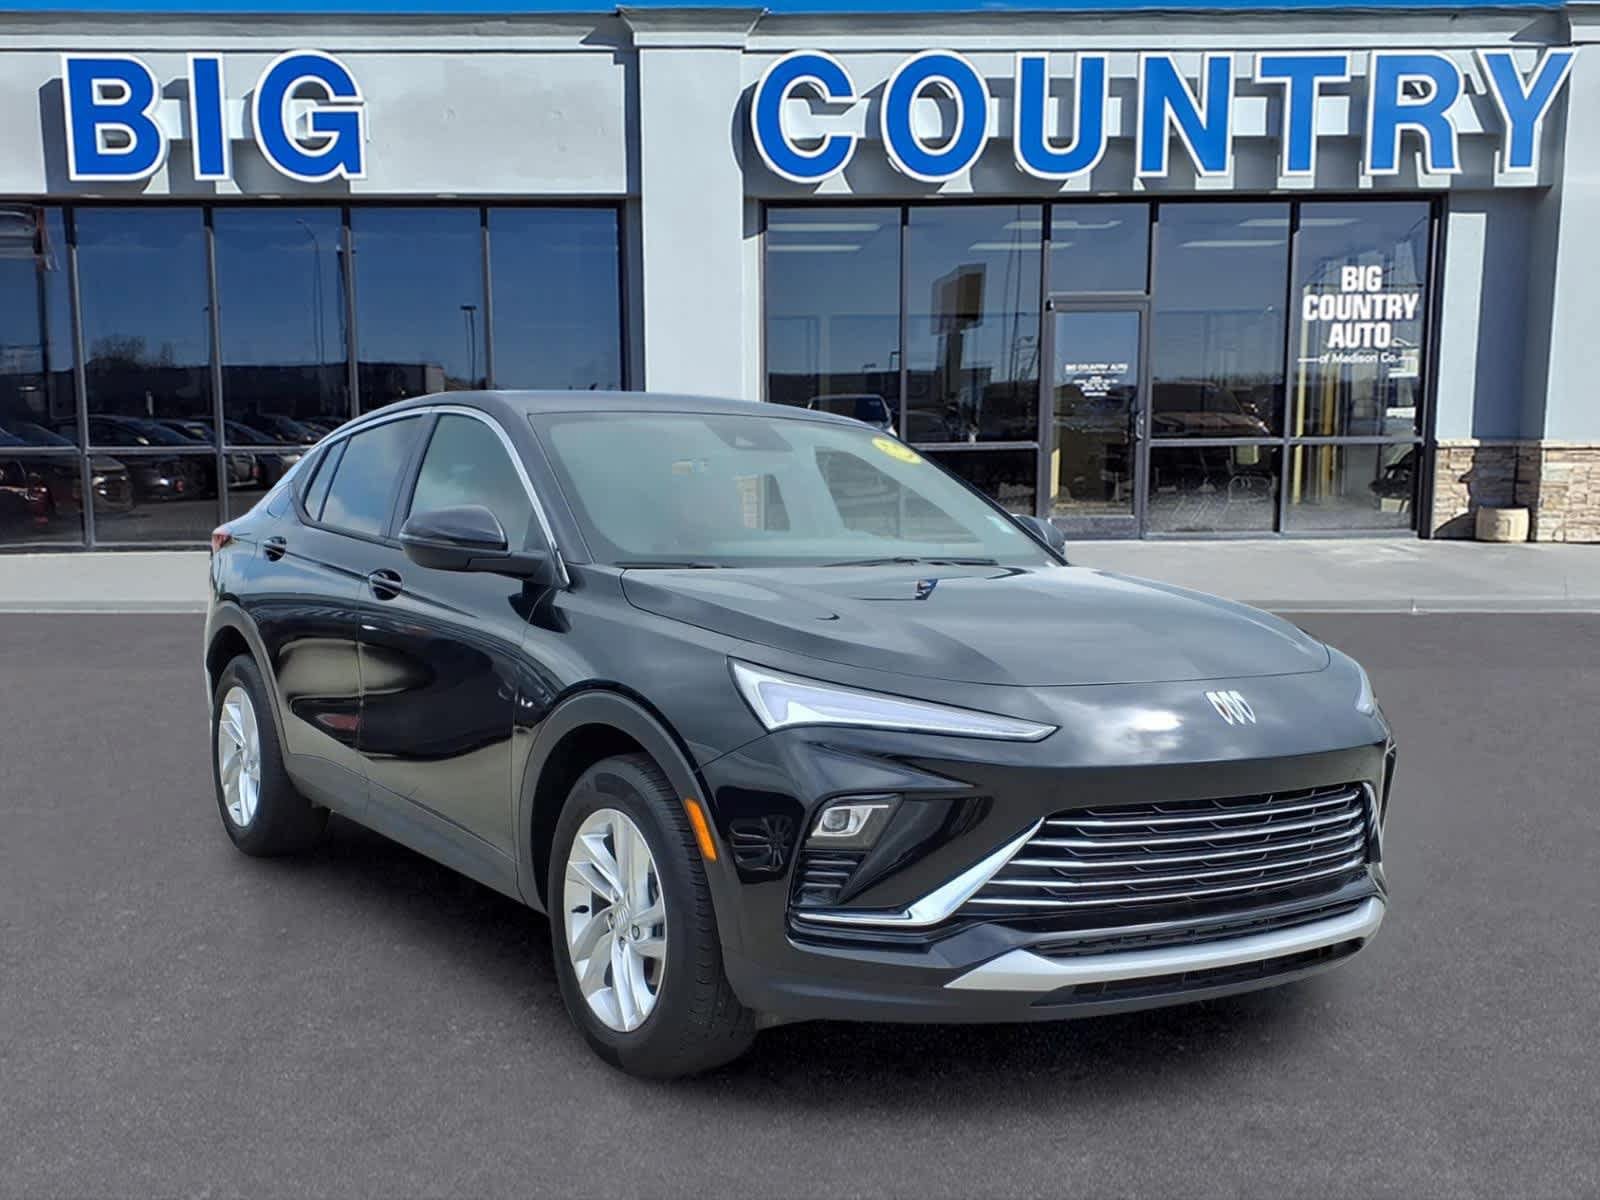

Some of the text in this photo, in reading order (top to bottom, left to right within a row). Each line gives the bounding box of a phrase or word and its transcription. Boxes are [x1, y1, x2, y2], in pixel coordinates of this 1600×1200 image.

[61, 48, 1577, 188] BIG COUNTRY
[1341, 265, 1382, 292] BIG
[1302, 293, 1419, 320] COUNTRY
[1327, 322, 1391, 349] AUTO
[1319, 353, 1329, 363] of
[1331, 352, 1378, 363] Madison
